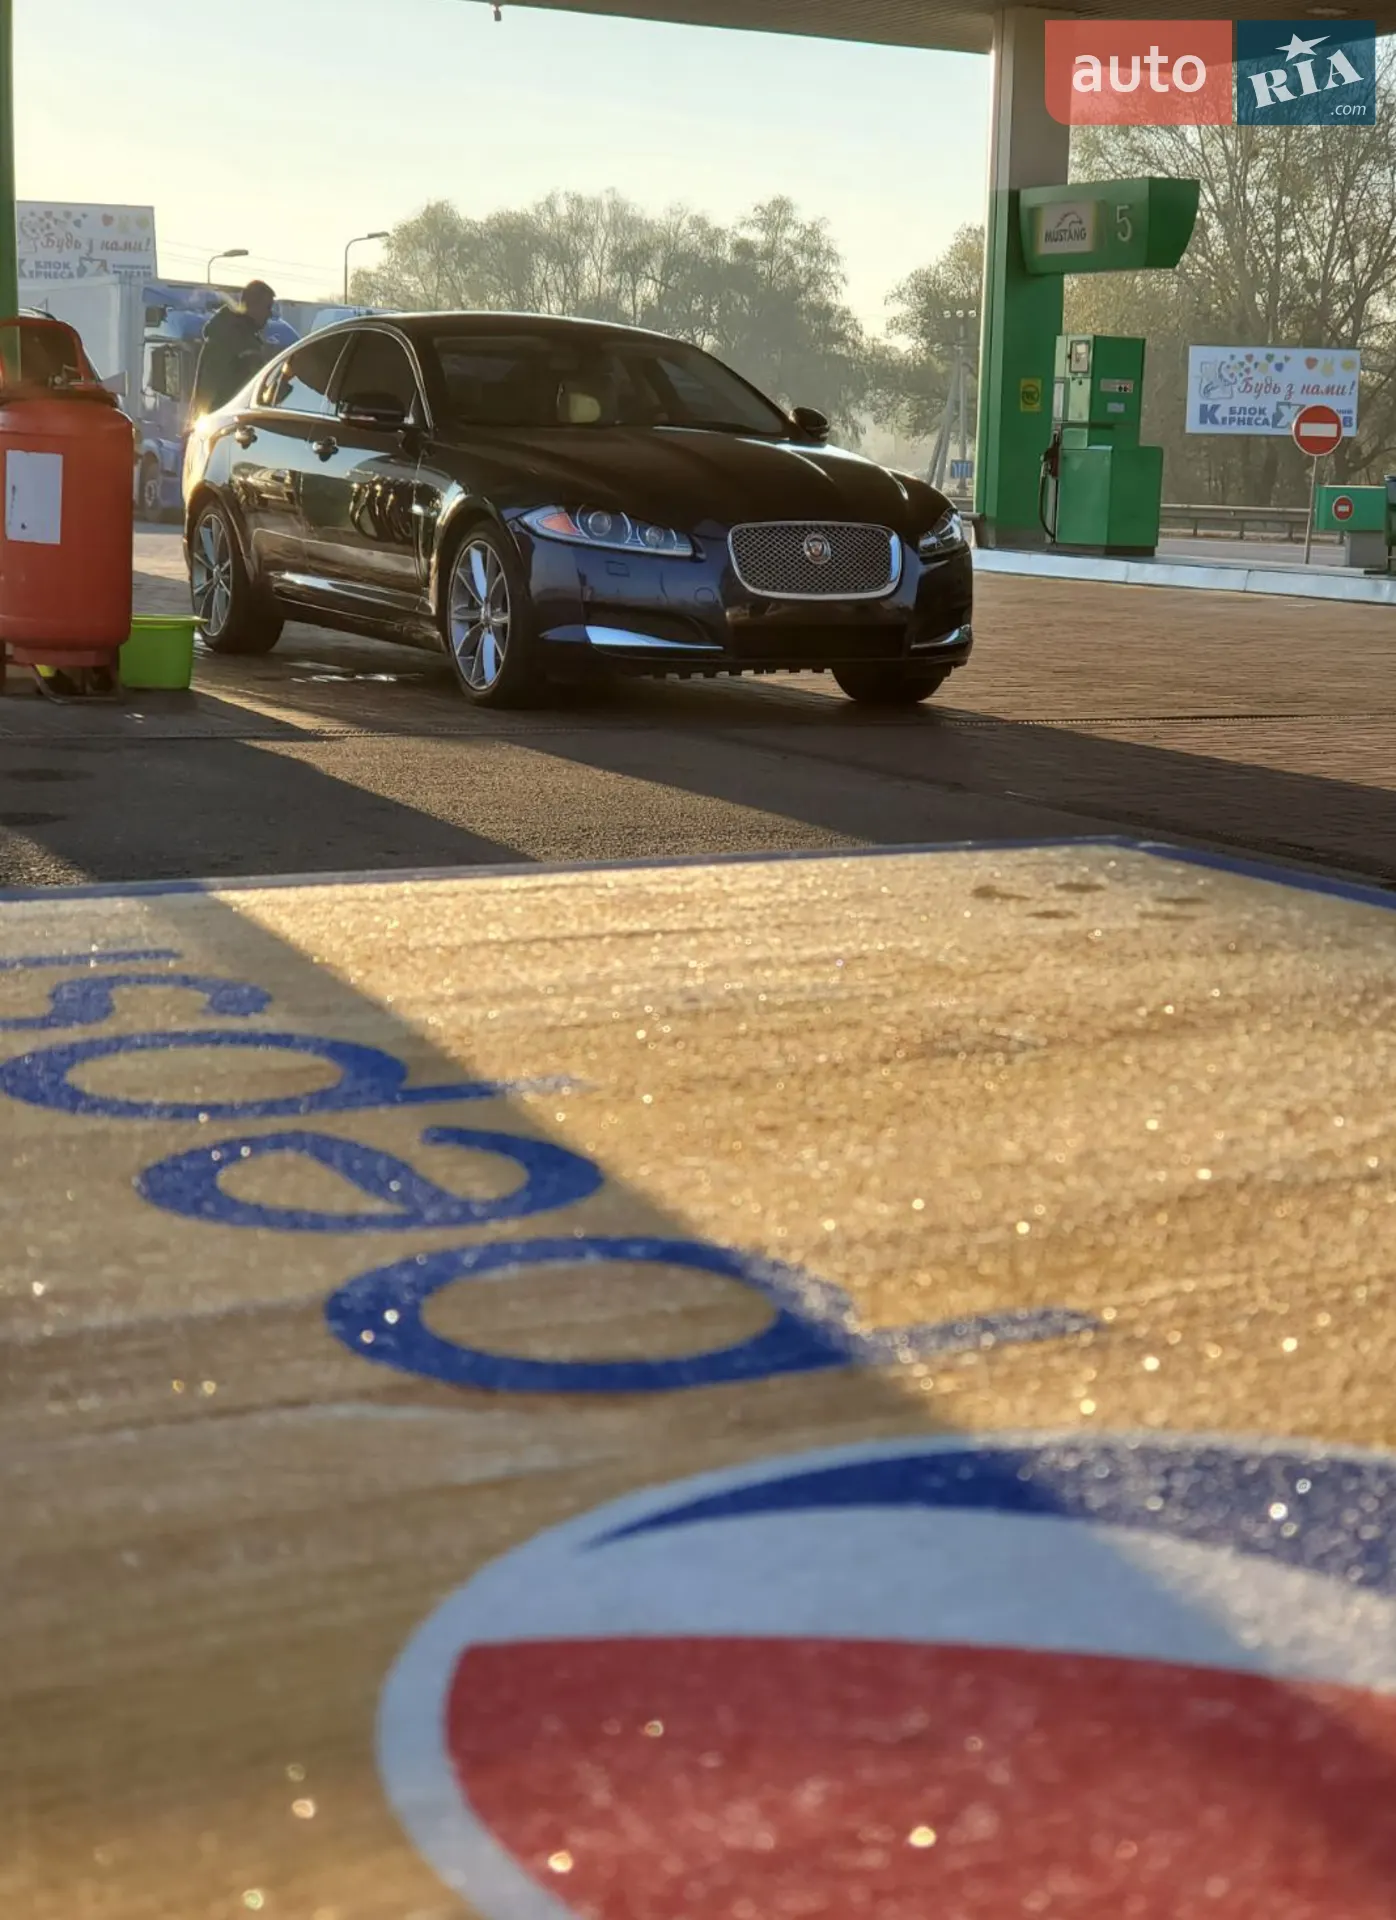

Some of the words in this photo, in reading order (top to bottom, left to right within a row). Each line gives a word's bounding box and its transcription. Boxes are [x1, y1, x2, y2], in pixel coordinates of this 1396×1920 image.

[1116, 204, 1132, 242] 5
[40, 232, 82, 254] Будь
[100, 237, 151, 253] нами!
[1045, 228, 1087, 243] MUSTANG
[35, 260, 71, 270] БЛОК
[1237, 375, 1281, 399] Будь
[1284, 383, 1295, 400] з
[1300, 380, 1356, 397] нами!
[1199, 403, 1271, 427] КЕРНЕСА
[1228, 406, 1267, 415] БЛОК
